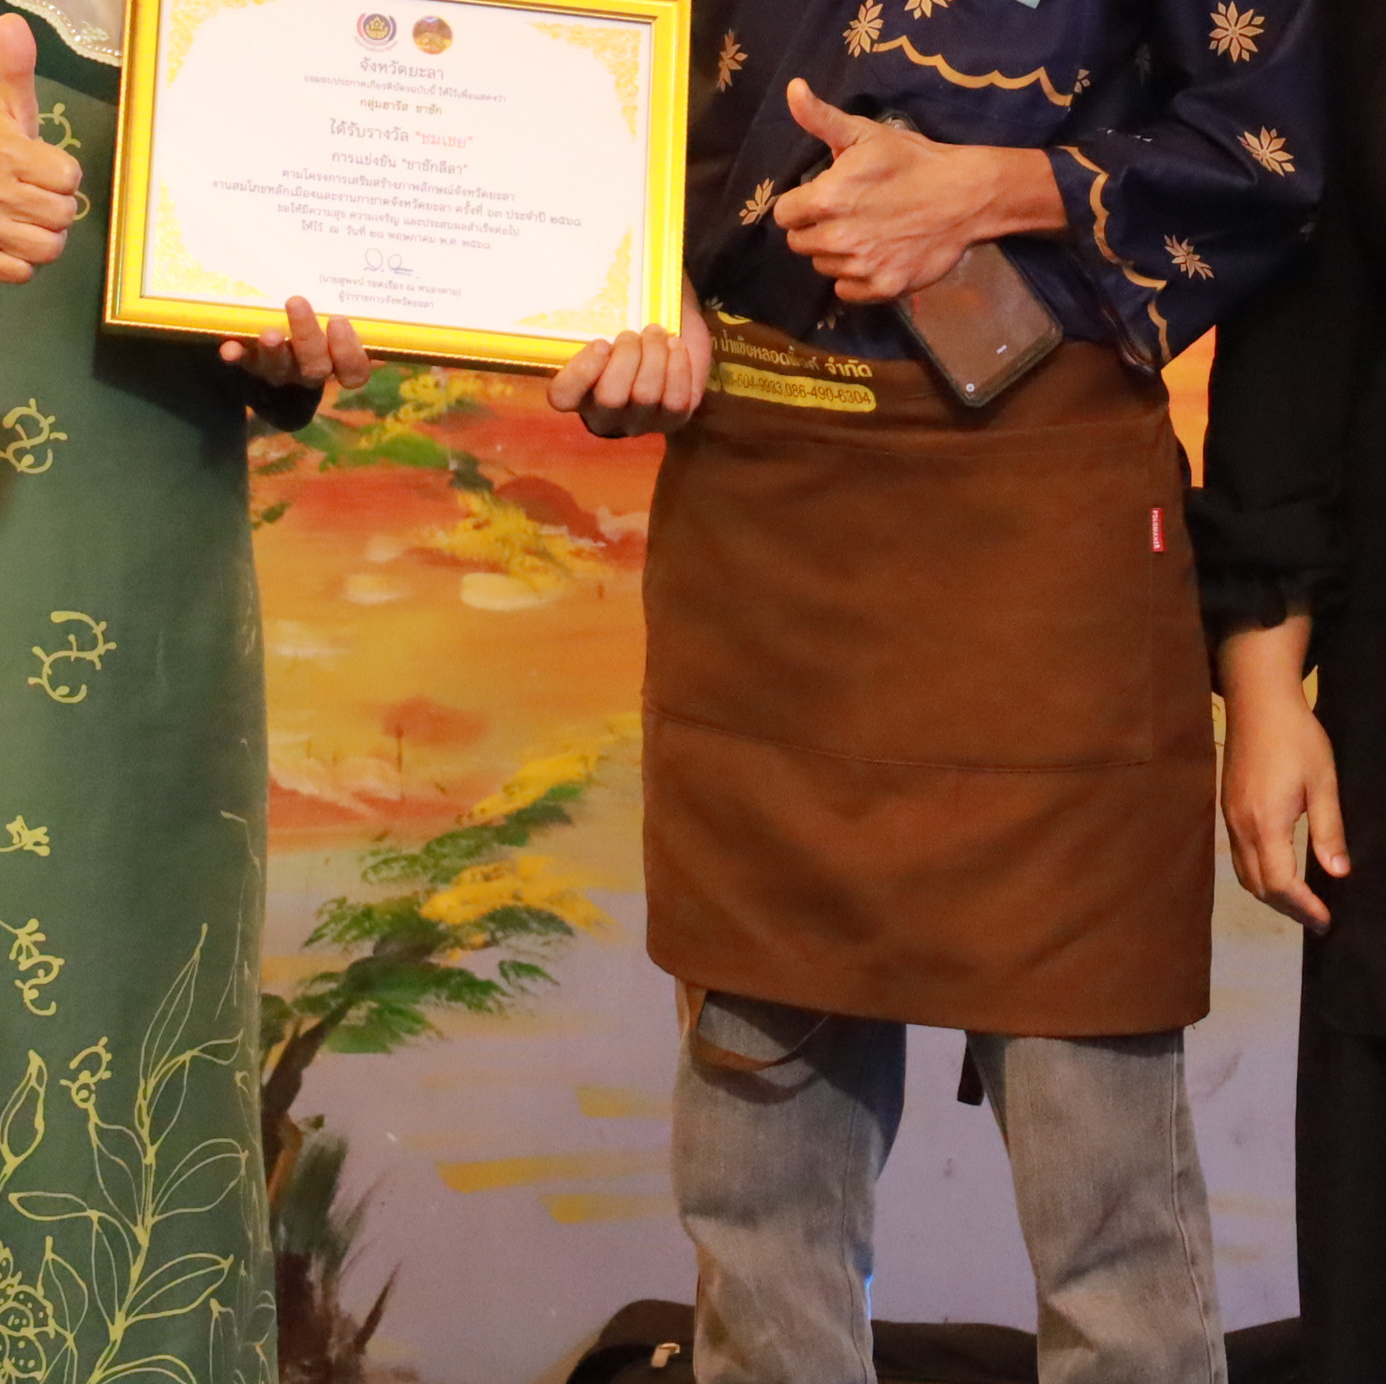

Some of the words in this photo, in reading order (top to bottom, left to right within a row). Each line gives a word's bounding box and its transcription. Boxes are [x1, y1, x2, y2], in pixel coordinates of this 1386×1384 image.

[359, 56, 444, 80] จังหวัดยะลา
[329, 117, 409, 143] ได้รับรางวัล
[824, 356, 873, 378] จำกัด
